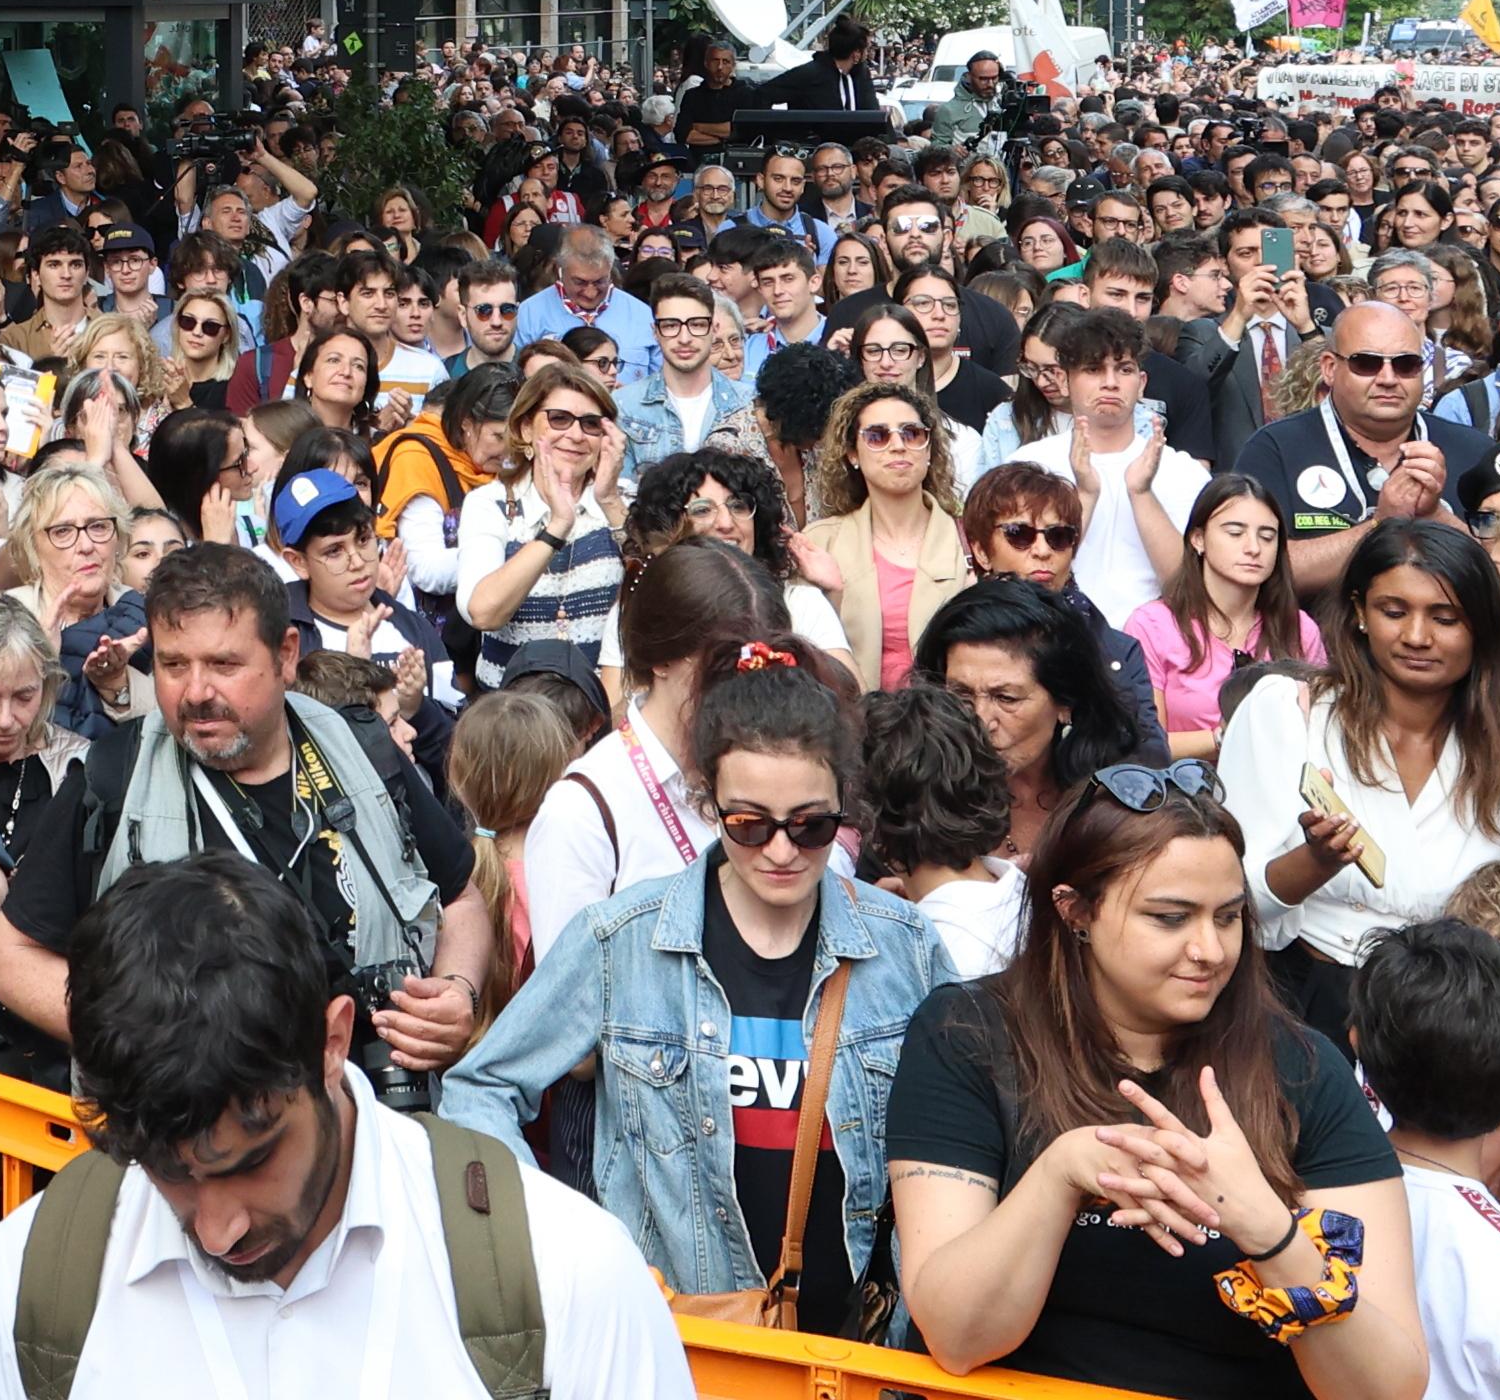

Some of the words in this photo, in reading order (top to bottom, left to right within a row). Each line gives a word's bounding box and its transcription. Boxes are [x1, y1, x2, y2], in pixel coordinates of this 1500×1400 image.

[1460, 73, 1479, 92] DI
[301, 741, 333, 791] Nikon
[633, 752, 661, 801] Palermo
[657, 802, 684, 842] chiama
